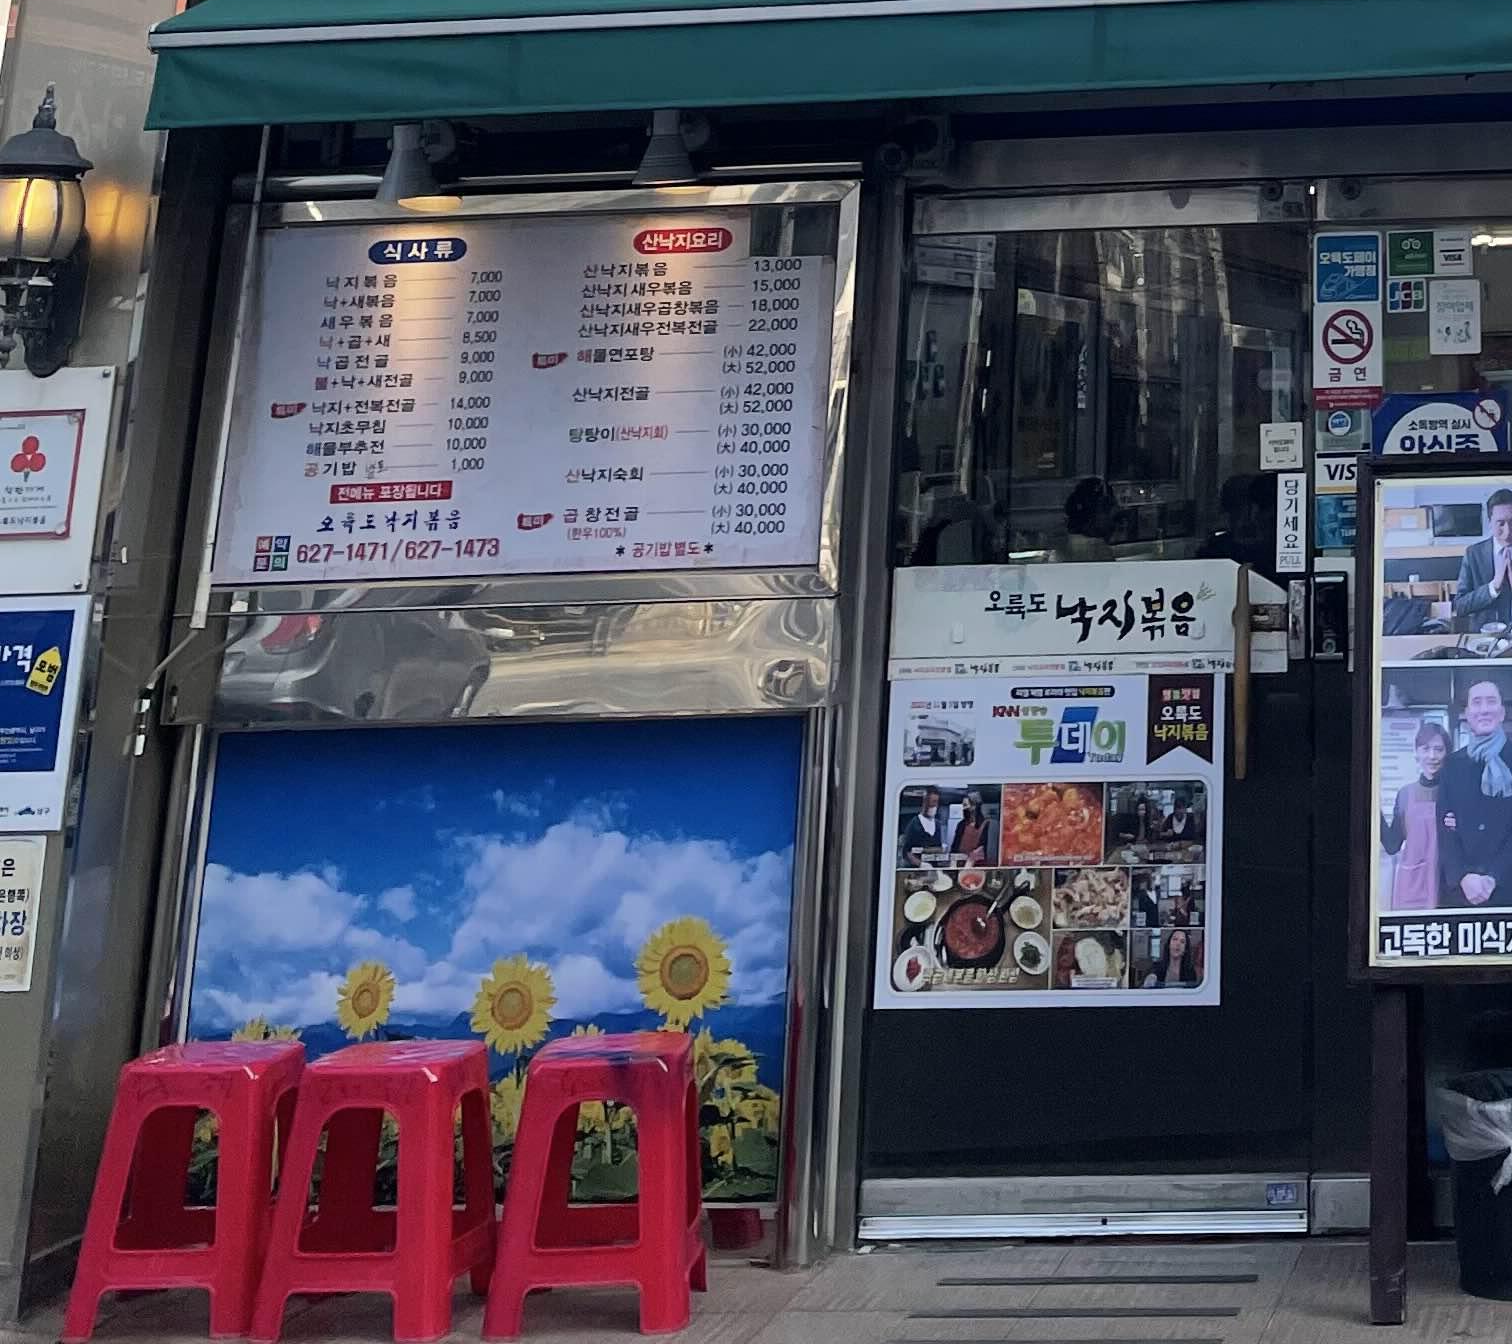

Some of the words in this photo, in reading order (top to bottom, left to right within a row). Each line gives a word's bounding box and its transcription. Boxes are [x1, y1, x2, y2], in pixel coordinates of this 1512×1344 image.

[642, 231, 723, 251] 산낙지요리
[753, 258, 802, 273] 13,000
[471, 271, 503, 285] 7,000
[752, 279, 800, 293] 15,000
[469, 290, 501, 304] 7,000
[1390, 289, 1423, 303] JCB
[751, 299, 799, 313] 18,000
[466, 311, 500, 325] 7,000
[748, 319, 798, 333] 22,000
[746, 343, 796, 357] 42,000
[460, 351, 495, 365] 9,000
[745, 360, 795, 374] 52,000
[458, 371, 493, 385] 9,000
[743, 382, 794, 396] 42,000
[450, 396, 491, 411] 14,000
[743, 399, 792, 413] 52,000
[447, 416, 489, 431] 10,000
[741, 422, 791, 436] 30,000
[446, 436, 487, 451] 10,000
[740, 440, 790, 454] 40,000
[451, 457, 485, 472] 1,000
[738, 463, 789, 477] 30,000
[1325, 463, 1357, 481] VIS
[736, 480, 788, 494] 40,000
[735, 503, 786, 517] 30,000
[1283, 479, 1300, 550] 당기세요
[734, 520, 785, 534] 40,000
[984, 590, 1049, 618] 오륙도
[1055, 586, 1197, 644] 낙지볶음
[1160, 705, 1203, 722] 오륙도
[1380, 921, 1450, 956] 고독한
